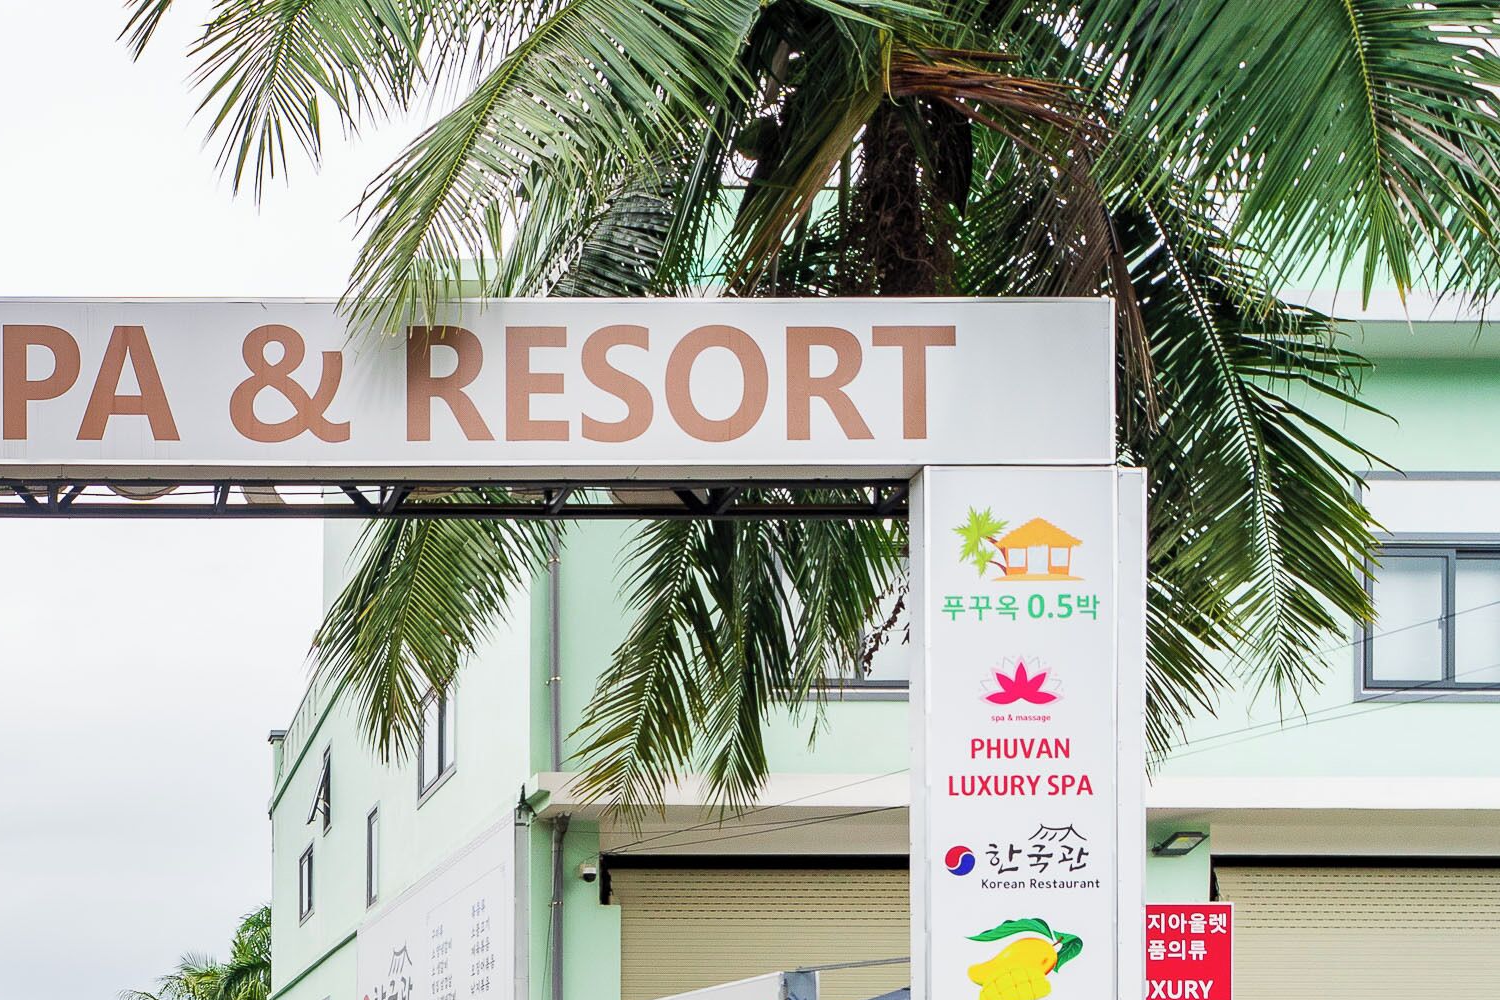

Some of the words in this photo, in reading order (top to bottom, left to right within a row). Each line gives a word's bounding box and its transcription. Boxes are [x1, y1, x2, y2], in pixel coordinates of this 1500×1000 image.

[228, 322, 352, 444] &
[405, 322, 957, 444] RESORT
[941, 595, 1019, 621] 푸꾸옥
[1027, 593, 1101, 621] 0.5박
[991, 714, 1005, 723] spa
[1007, 714, 1013, 722] &
[1016, 714, 1051, 723] massage
[971, 738, 1071, 760] PHUVAN
[948, 775, 1041, 797] LUXURY
[1047, 774, 1094, 796] SPA
[985, 843, 1089, 873] 한국관
[981, 878, 1025, 889] Korean
[1030, 878, 1100, 889] Restaurant
